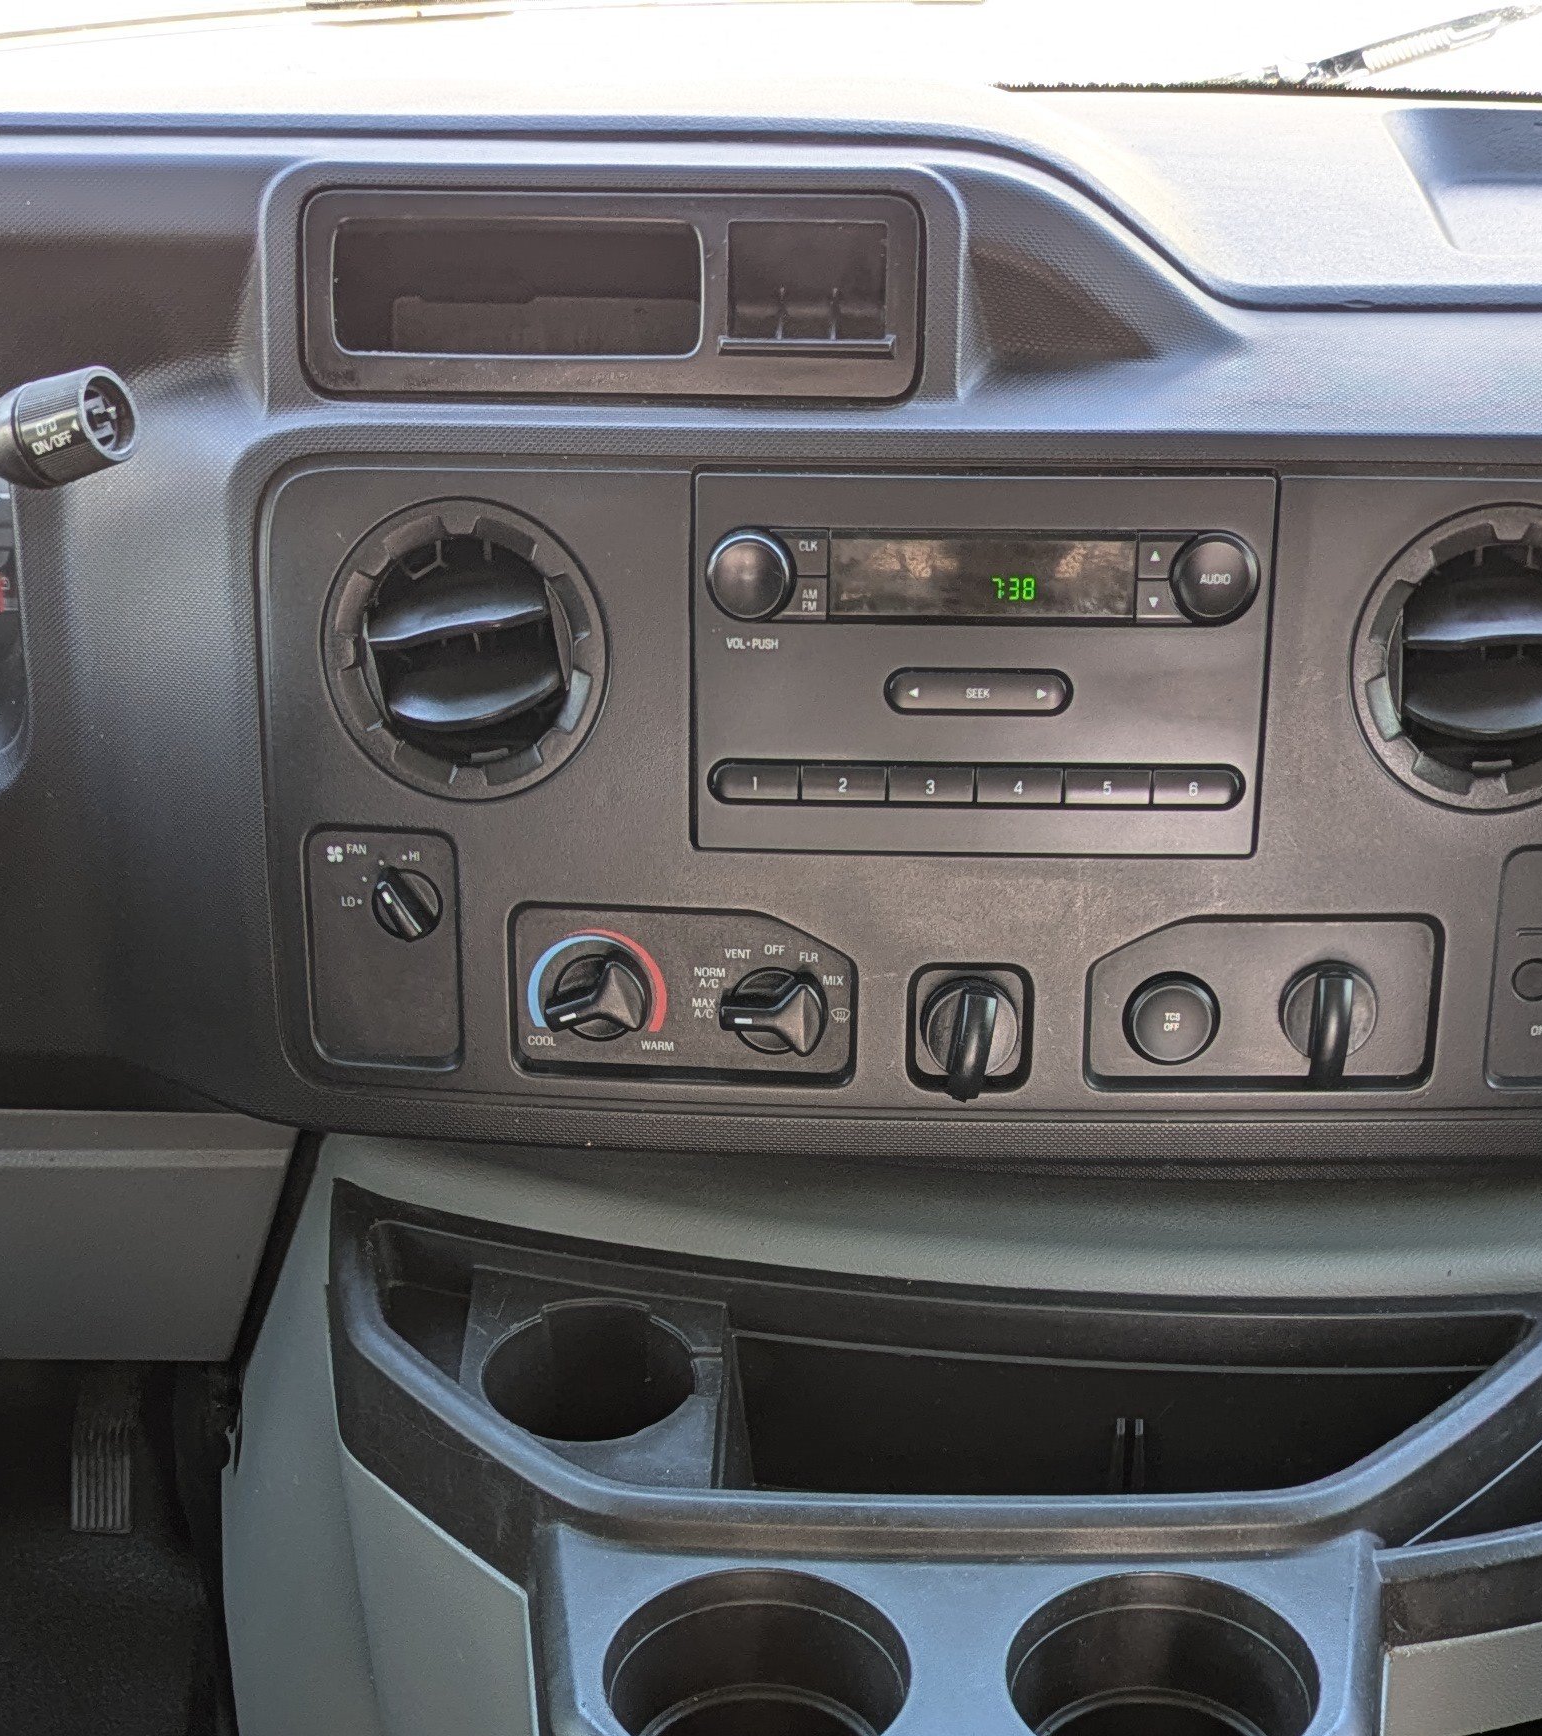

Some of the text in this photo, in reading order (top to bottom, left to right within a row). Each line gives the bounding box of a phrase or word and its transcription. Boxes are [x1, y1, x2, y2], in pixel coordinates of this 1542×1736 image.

[31, 430, 73, 456] ON/OFF
[799, 540, 819, 552] CLK
[1200, 573, 1232, 585] AUDIO
[801, 588, 819, 600] AM
[992, 576, 1036, 600] 7:38
[801, 600, 818, 611] FM
[965, 687, 991, 699] SEEK
[751, 775, 759, 792] 1
[837, 777, 849, 793] 2
[925, 779, 937, 795] 3
[1013, 780, 1024, 795] 4
[1102, 780, 1113, 796] 5
[1187, 781, 1199, 797] 6
[346, 843, 367, 856] FAN
[408, 850, 421, 862] HI
[341, 896, 356, 908] LO
[724, 947, 752, 960] VENT
[764, 944, 786, 956] OFF
[798, 951, 819, 963] FLR
[693, 966, 726, 978] NORM
[698, 977, 720, 989] A/C
[822, 974, 845, 987] MIX
[691, 997, 716, 1009] MAX
[693, 1007, 715, 1019] A/C
[1164, 1012, 1181, 1022] TCS
[1163, 1022, 1180, 1032] OFF
[527, 1034, 557, 1047] COOL
[640, 1040, 675, 1052] WARM
